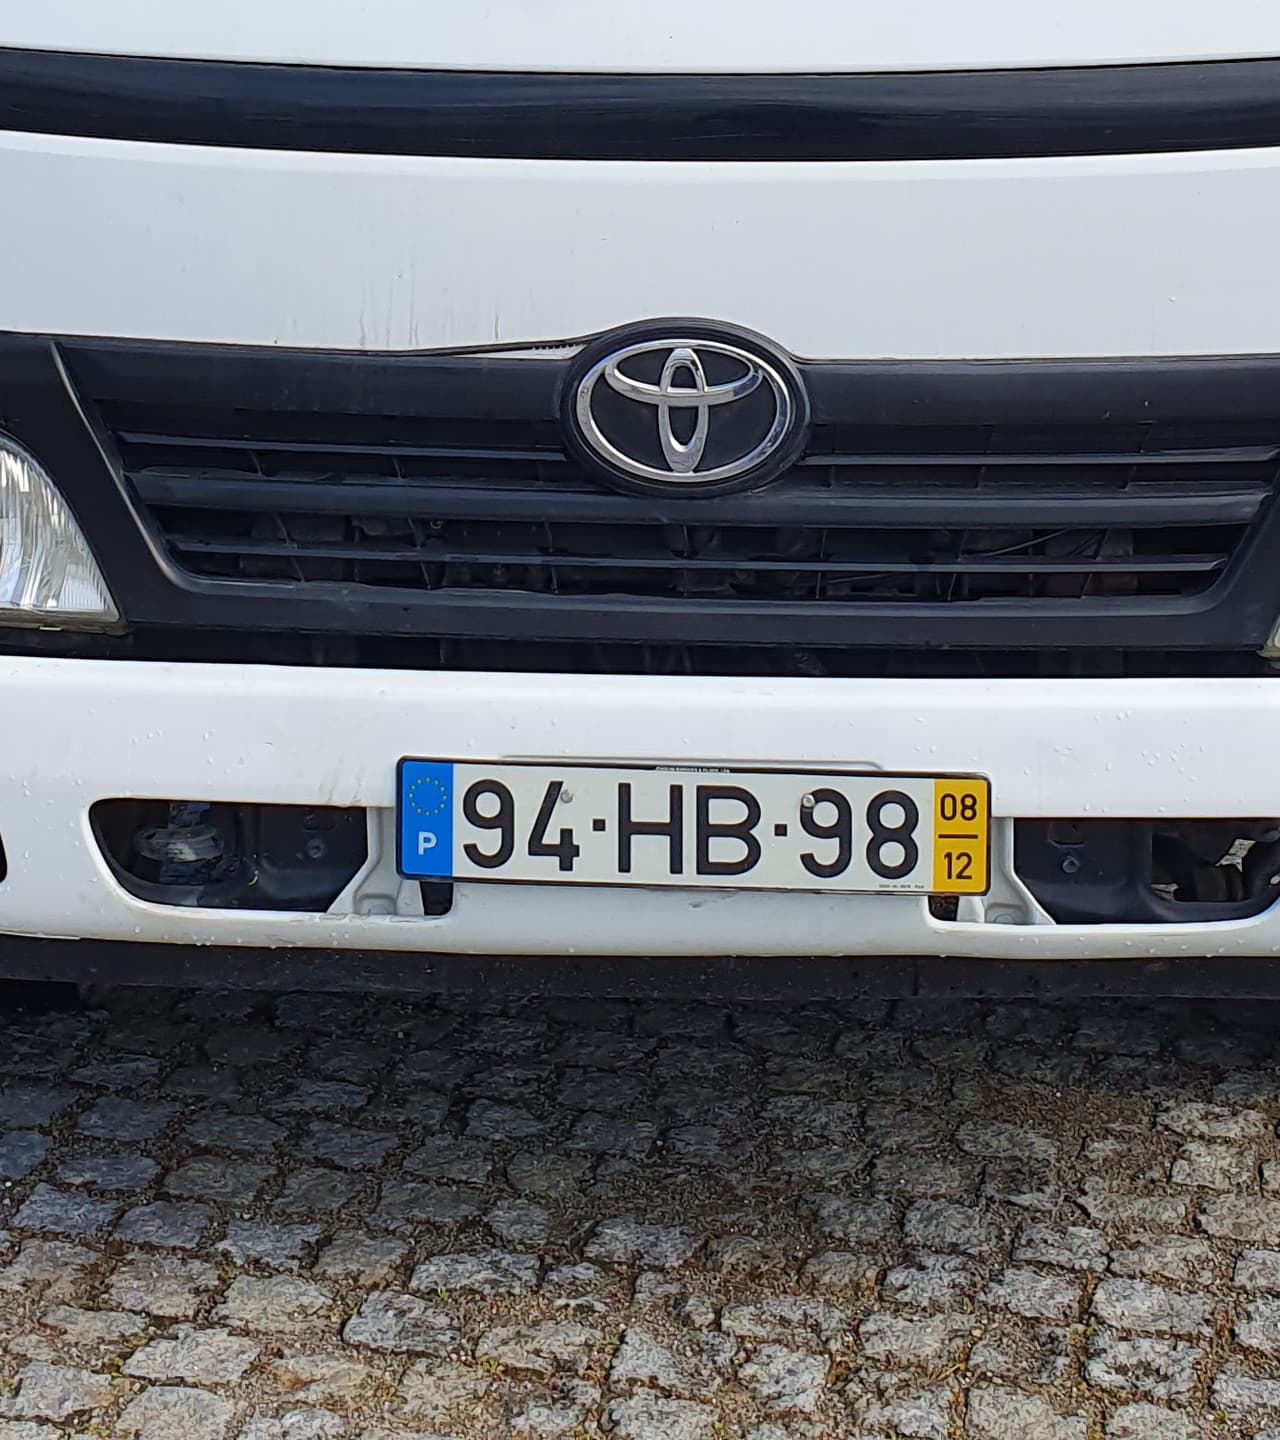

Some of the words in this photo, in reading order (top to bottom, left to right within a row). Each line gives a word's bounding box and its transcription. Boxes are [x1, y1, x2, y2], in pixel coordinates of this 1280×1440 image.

[939, 792, 978, 823] 08
[418, 831, 437, 856] P
[943, 851, 974, 881] 12
